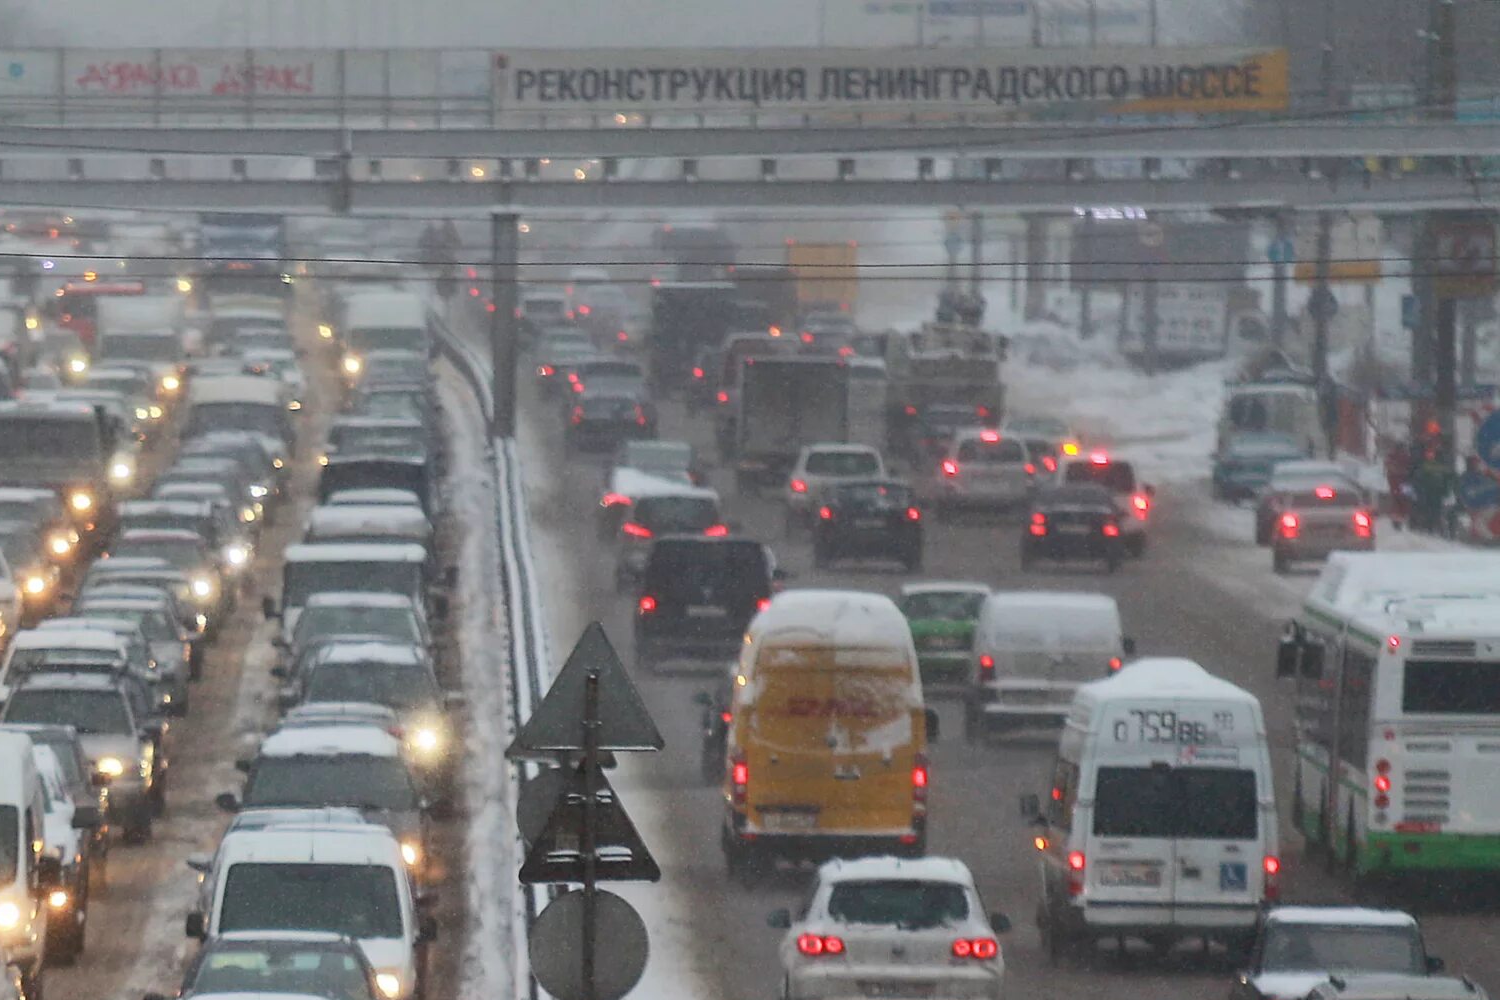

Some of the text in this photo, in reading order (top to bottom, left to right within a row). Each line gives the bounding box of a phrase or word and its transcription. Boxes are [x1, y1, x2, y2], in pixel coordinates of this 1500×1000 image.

[515, 64, 1263, 106] РЕКОНСТРУКЦИЯ ЛЕНИНГРАДСКОГО ШОССЕ
